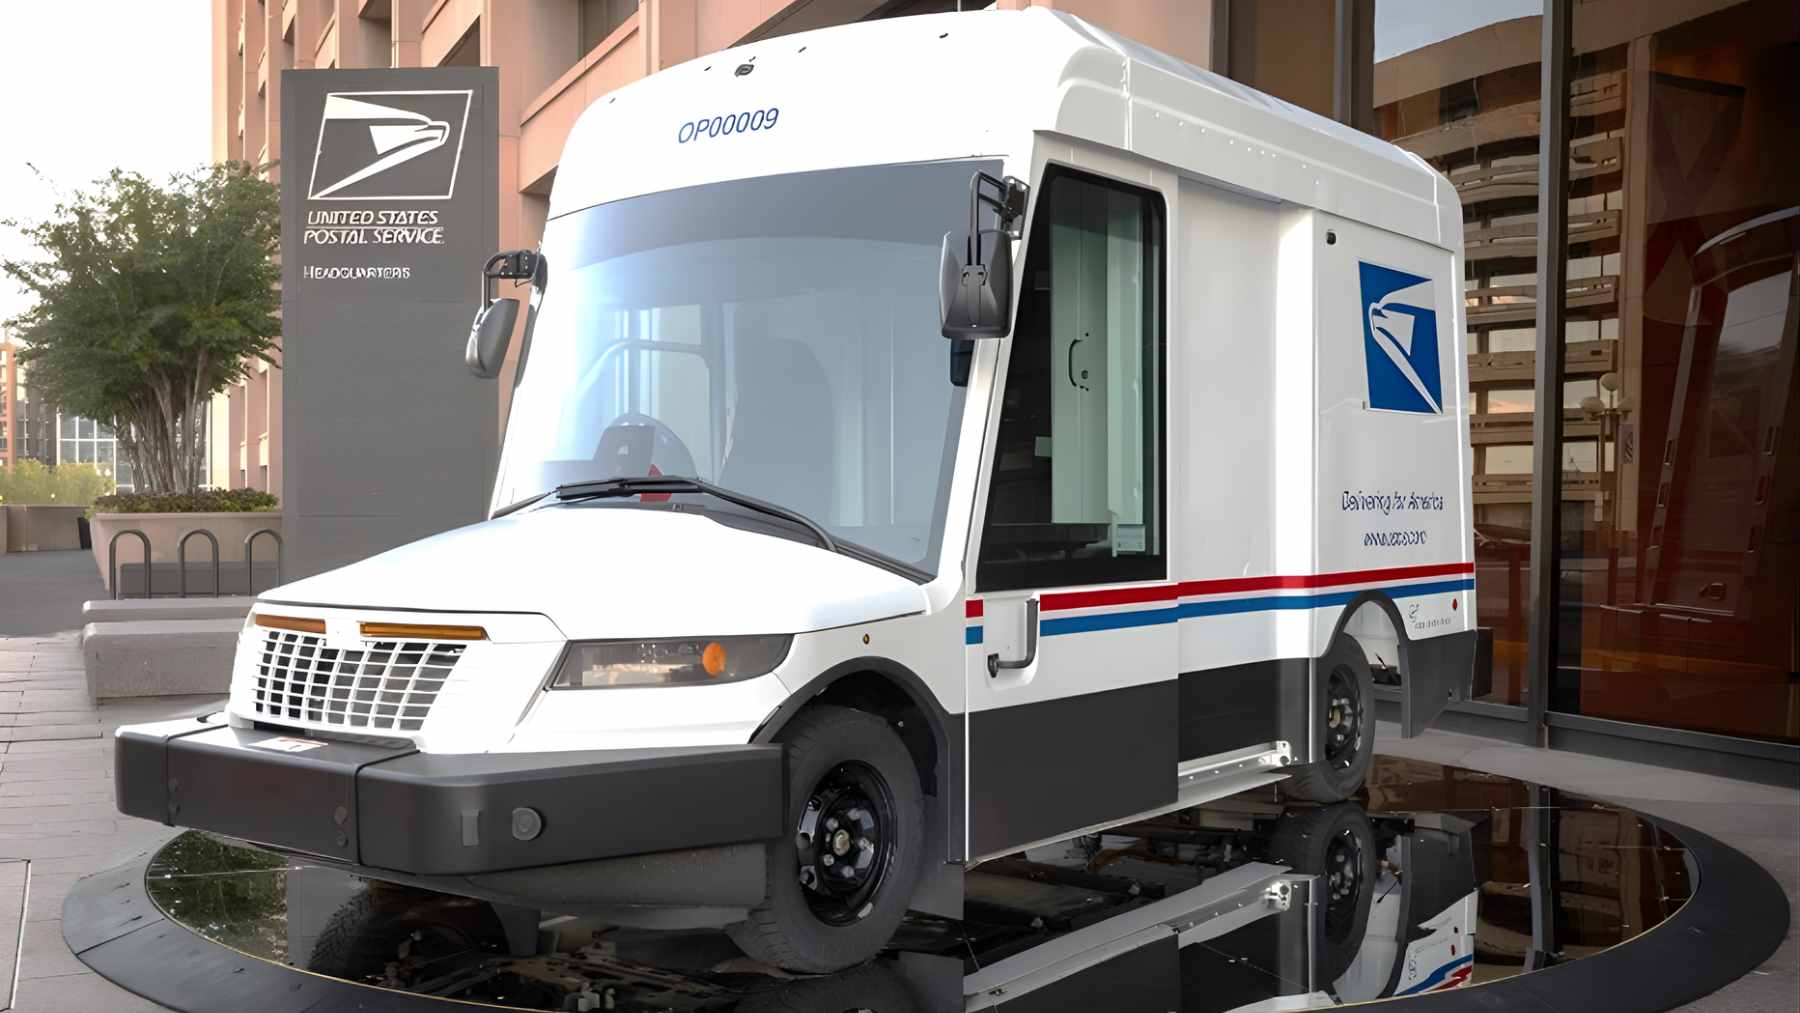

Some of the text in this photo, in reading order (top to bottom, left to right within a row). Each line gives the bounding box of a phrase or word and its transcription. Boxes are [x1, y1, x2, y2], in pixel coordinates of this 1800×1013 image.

[678, 107, 780, 144] OP00009
[307, 210, 439, 225] UNITED STATES
[303, 228, 444, 245] POSTAL SERVICE
